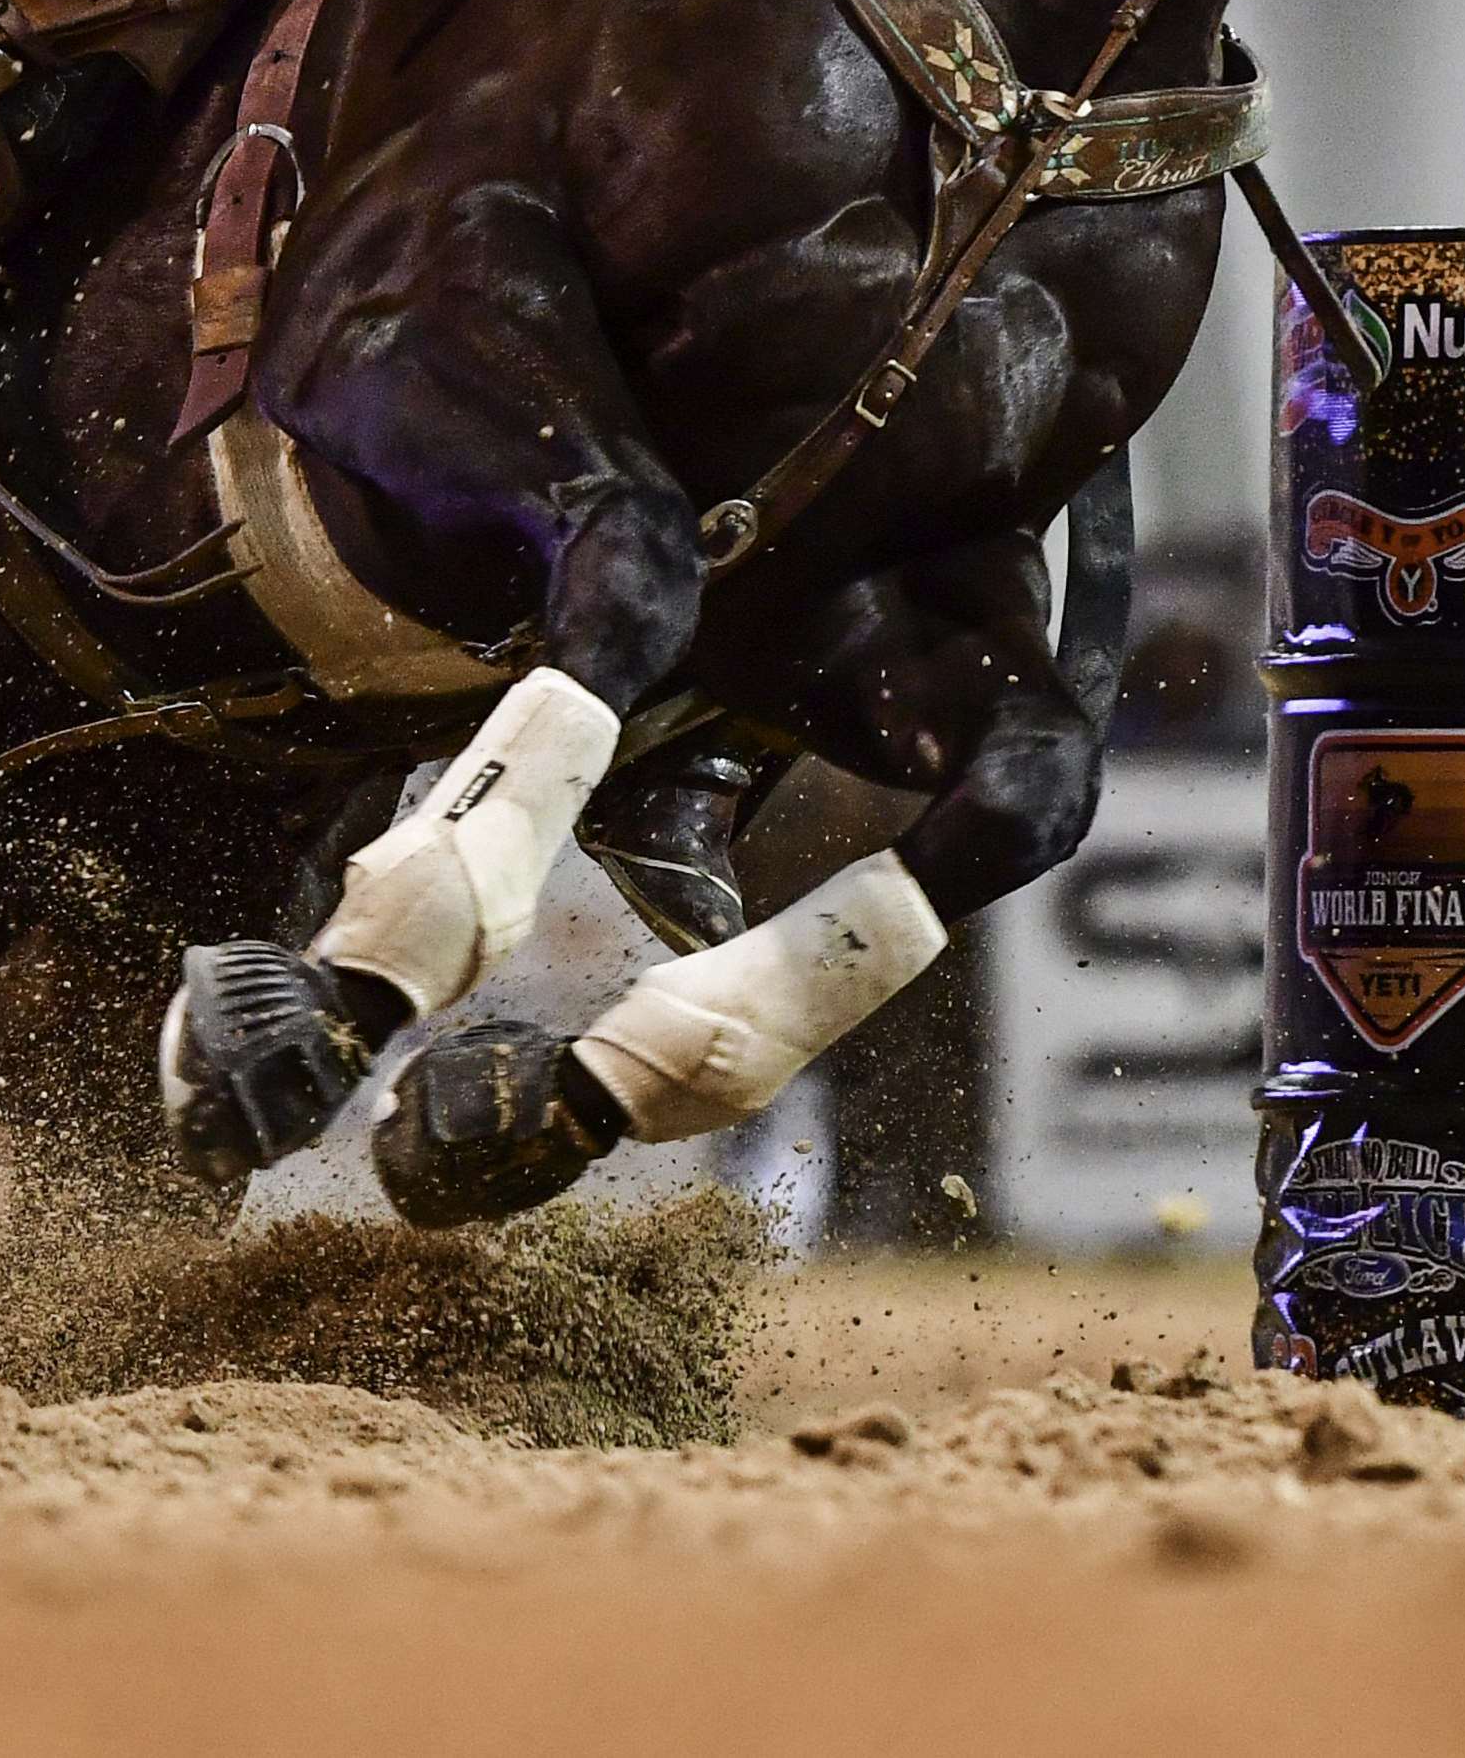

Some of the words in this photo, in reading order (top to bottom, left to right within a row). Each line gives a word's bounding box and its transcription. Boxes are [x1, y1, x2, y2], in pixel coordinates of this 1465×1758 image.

[1113, 148, 1211, 192] Christ
[1364, 870, 1422, 886] JUNIOR
[1311, 890, 1386, 926] WORLD
[1358, 973, 1422, 998] YETI
